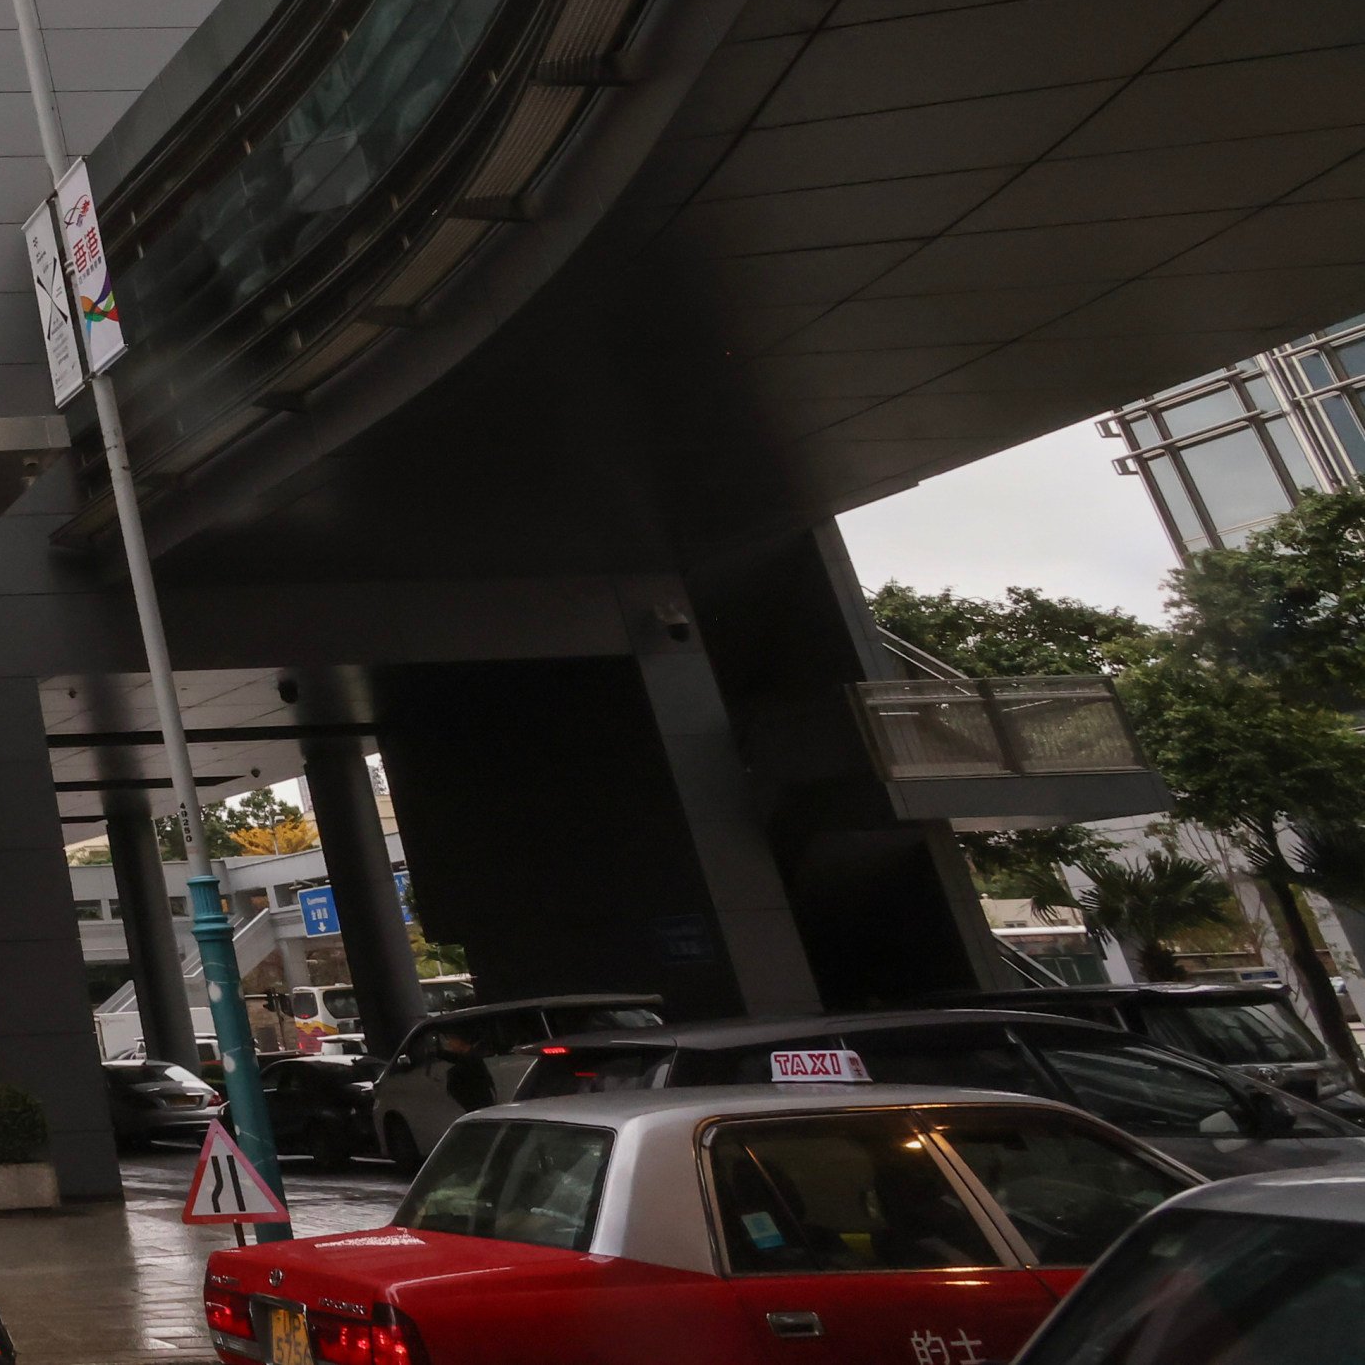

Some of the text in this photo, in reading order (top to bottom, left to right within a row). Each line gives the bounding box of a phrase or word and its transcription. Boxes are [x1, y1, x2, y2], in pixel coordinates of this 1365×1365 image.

[73, 226, 100, 274] 香港
[773, 1052, 842, 1076] TAXI
[909, 1328, 987, 1365] 的士
